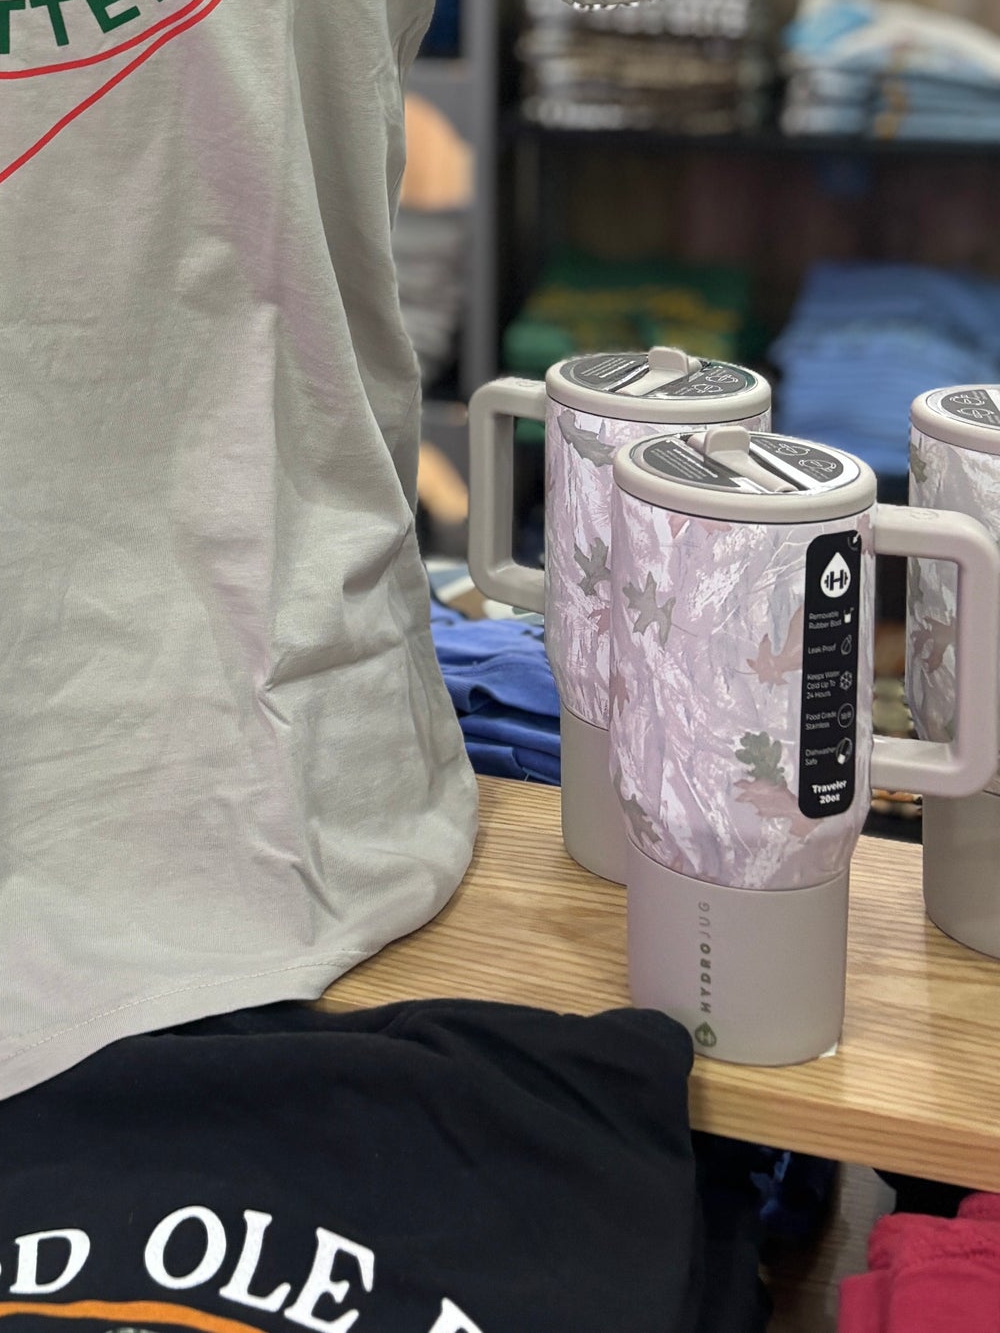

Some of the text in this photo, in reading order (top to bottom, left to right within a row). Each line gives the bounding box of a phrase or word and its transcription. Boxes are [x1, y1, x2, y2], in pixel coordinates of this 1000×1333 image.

[808, 621, 830, 629] Rubber
[808, 643, 837, 654] Leak Proof
[806, 681, 821, 689] Cold
[805, 712, 821, 721] Food
[805, 757, 818, 766] Safe
[811, 780, 847, 794] Traveler
[819, 794, 841, 805] 20oz
[698, 902, 712, 1014] HYDROJUG
[144, 1205, 375, 1333] OLE
